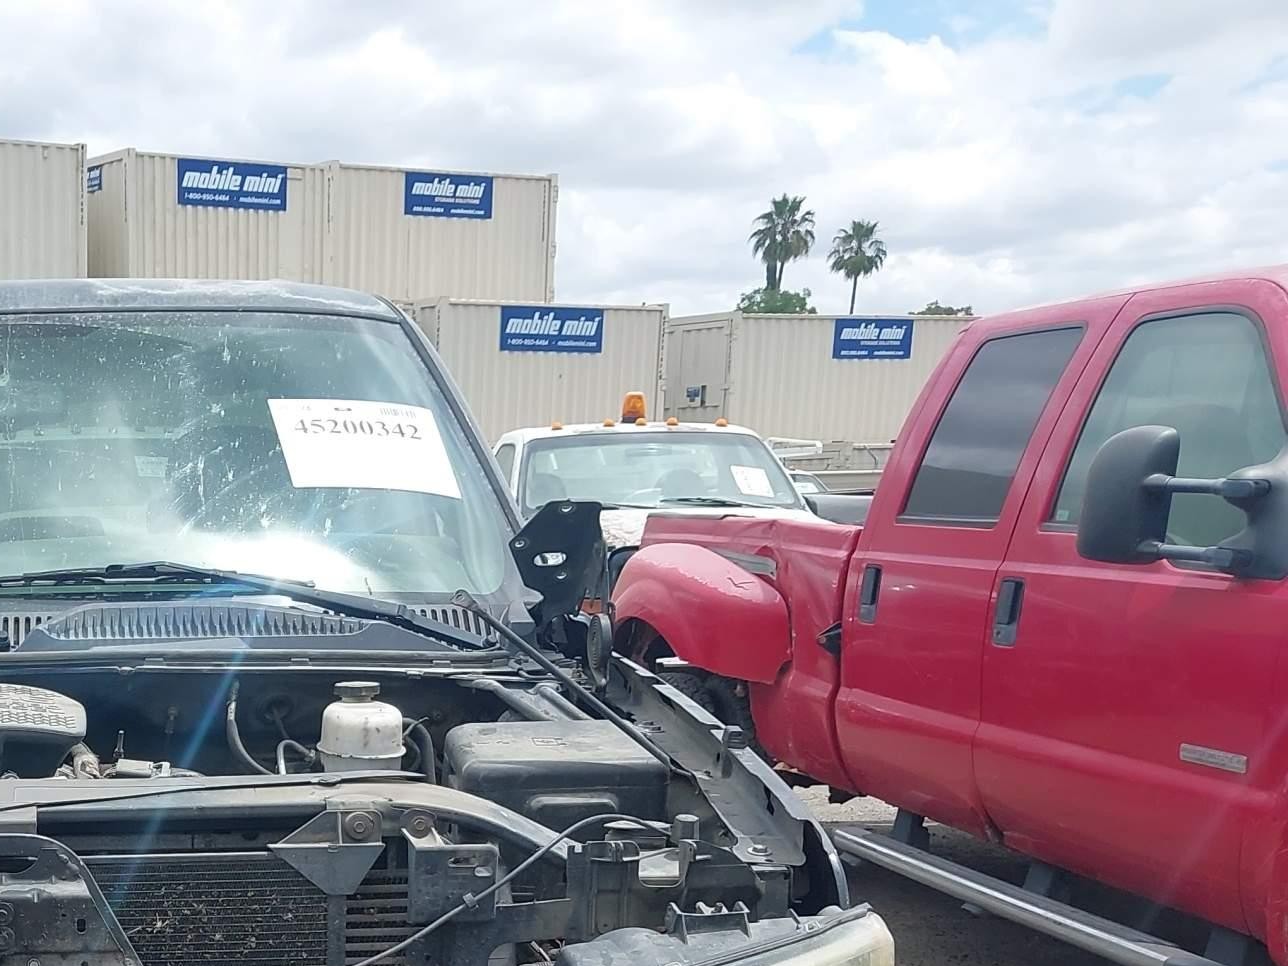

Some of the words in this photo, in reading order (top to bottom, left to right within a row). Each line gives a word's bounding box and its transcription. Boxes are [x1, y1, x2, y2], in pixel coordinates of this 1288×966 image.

[181, 166, 242, 190] mobile
[243, 172, 284, 194] mini
[411, 178, 455, 196] mobile
[455, 182, 486, 198] mini
[505, 311, 561, 335] mobile
[561, 316, 600, 336] mini
[839, 322, 880, 340] mobile
[879, 325, 907, 340] mini
[294, 418, 423, 440] 45200342
